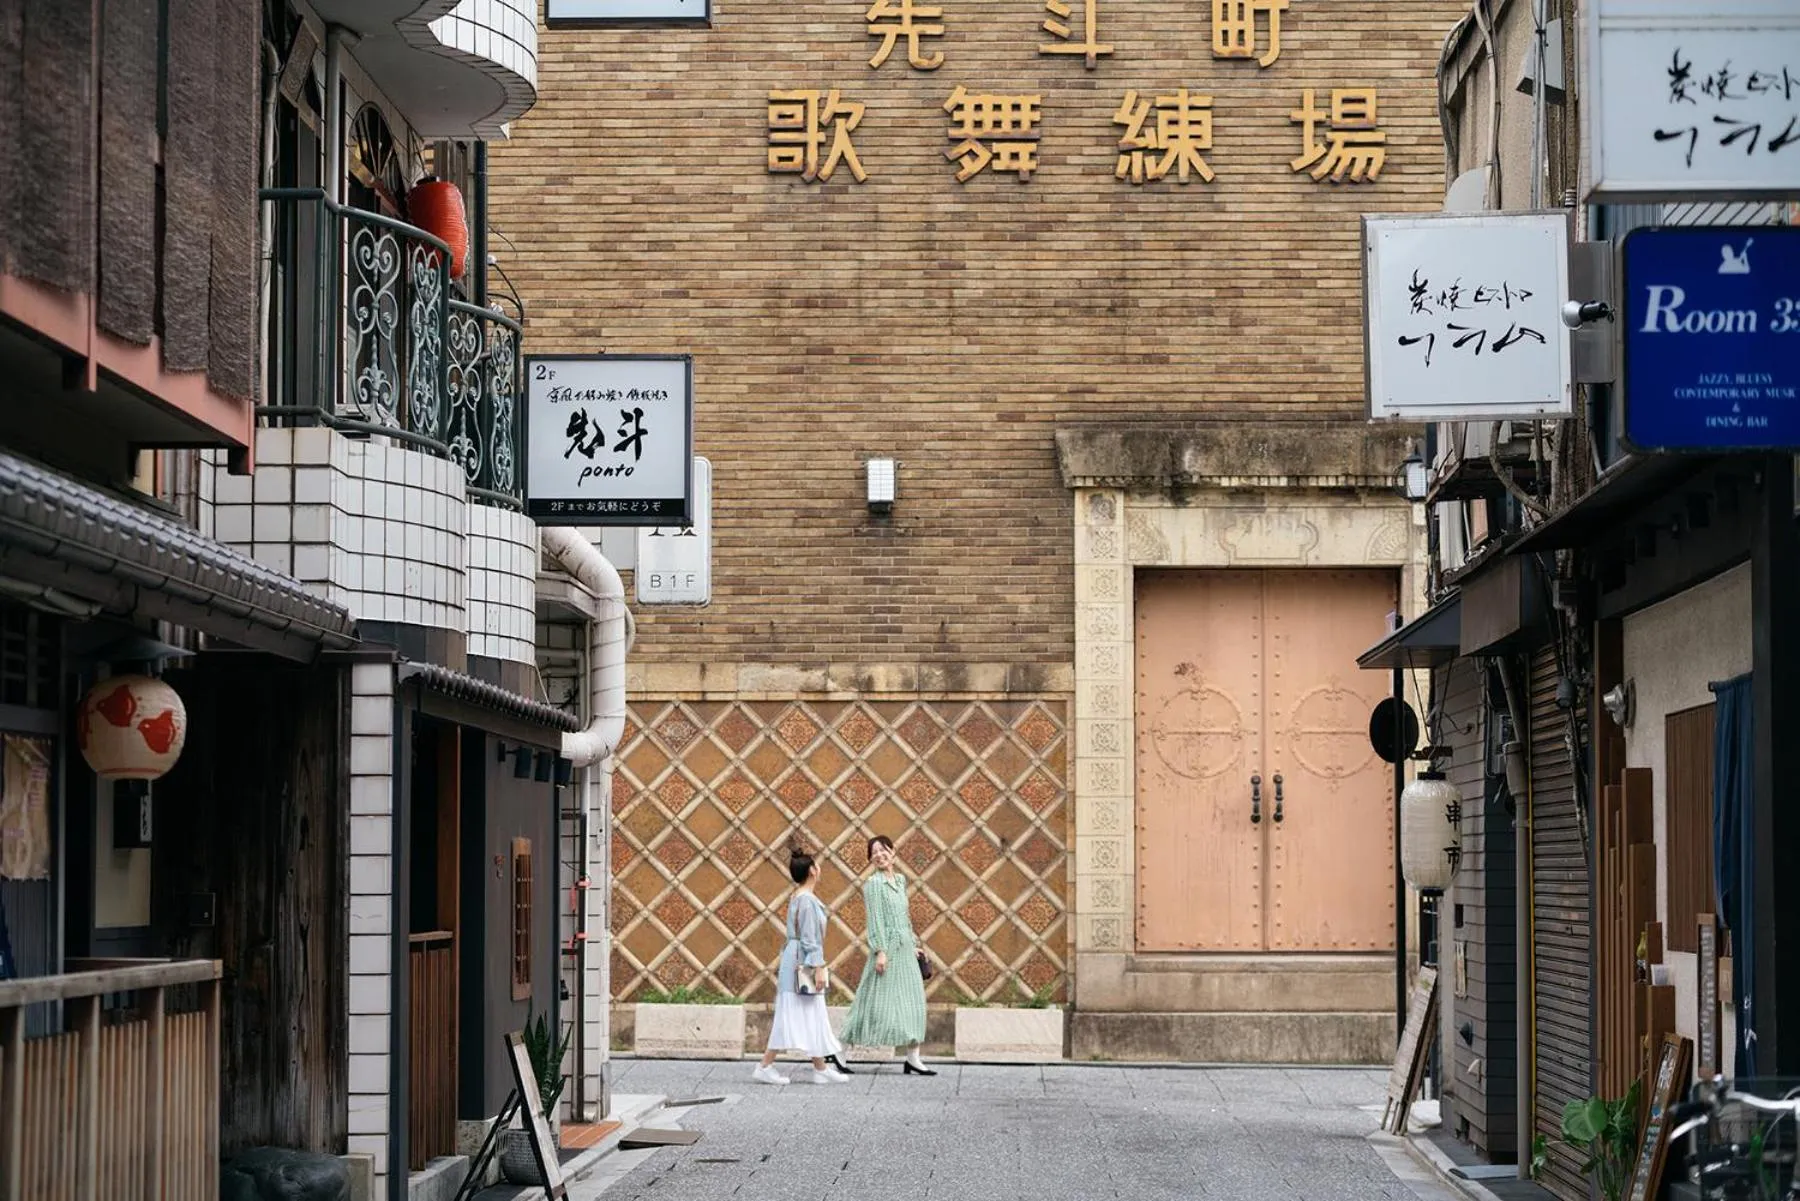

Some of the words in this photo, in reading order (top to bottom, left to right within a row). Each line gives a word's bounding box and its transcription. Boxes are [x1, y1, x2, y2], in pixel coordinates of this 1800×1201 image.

[767, 84, 1389, 184] 歌舞練場
[1640, 284, 1758, 334] Room
[1770, 297, 1800, 334] 3
[535, 364, 556, 381] 2F
[1674, 387, 1761, 399] CONTEMPORARY
[1706, 416, 1743, 428] DINING
[1747, 416, 1769, 428] BAR
[577, 464, 635, 488] ponto
[1443, 800, 1462, 877] 串市
